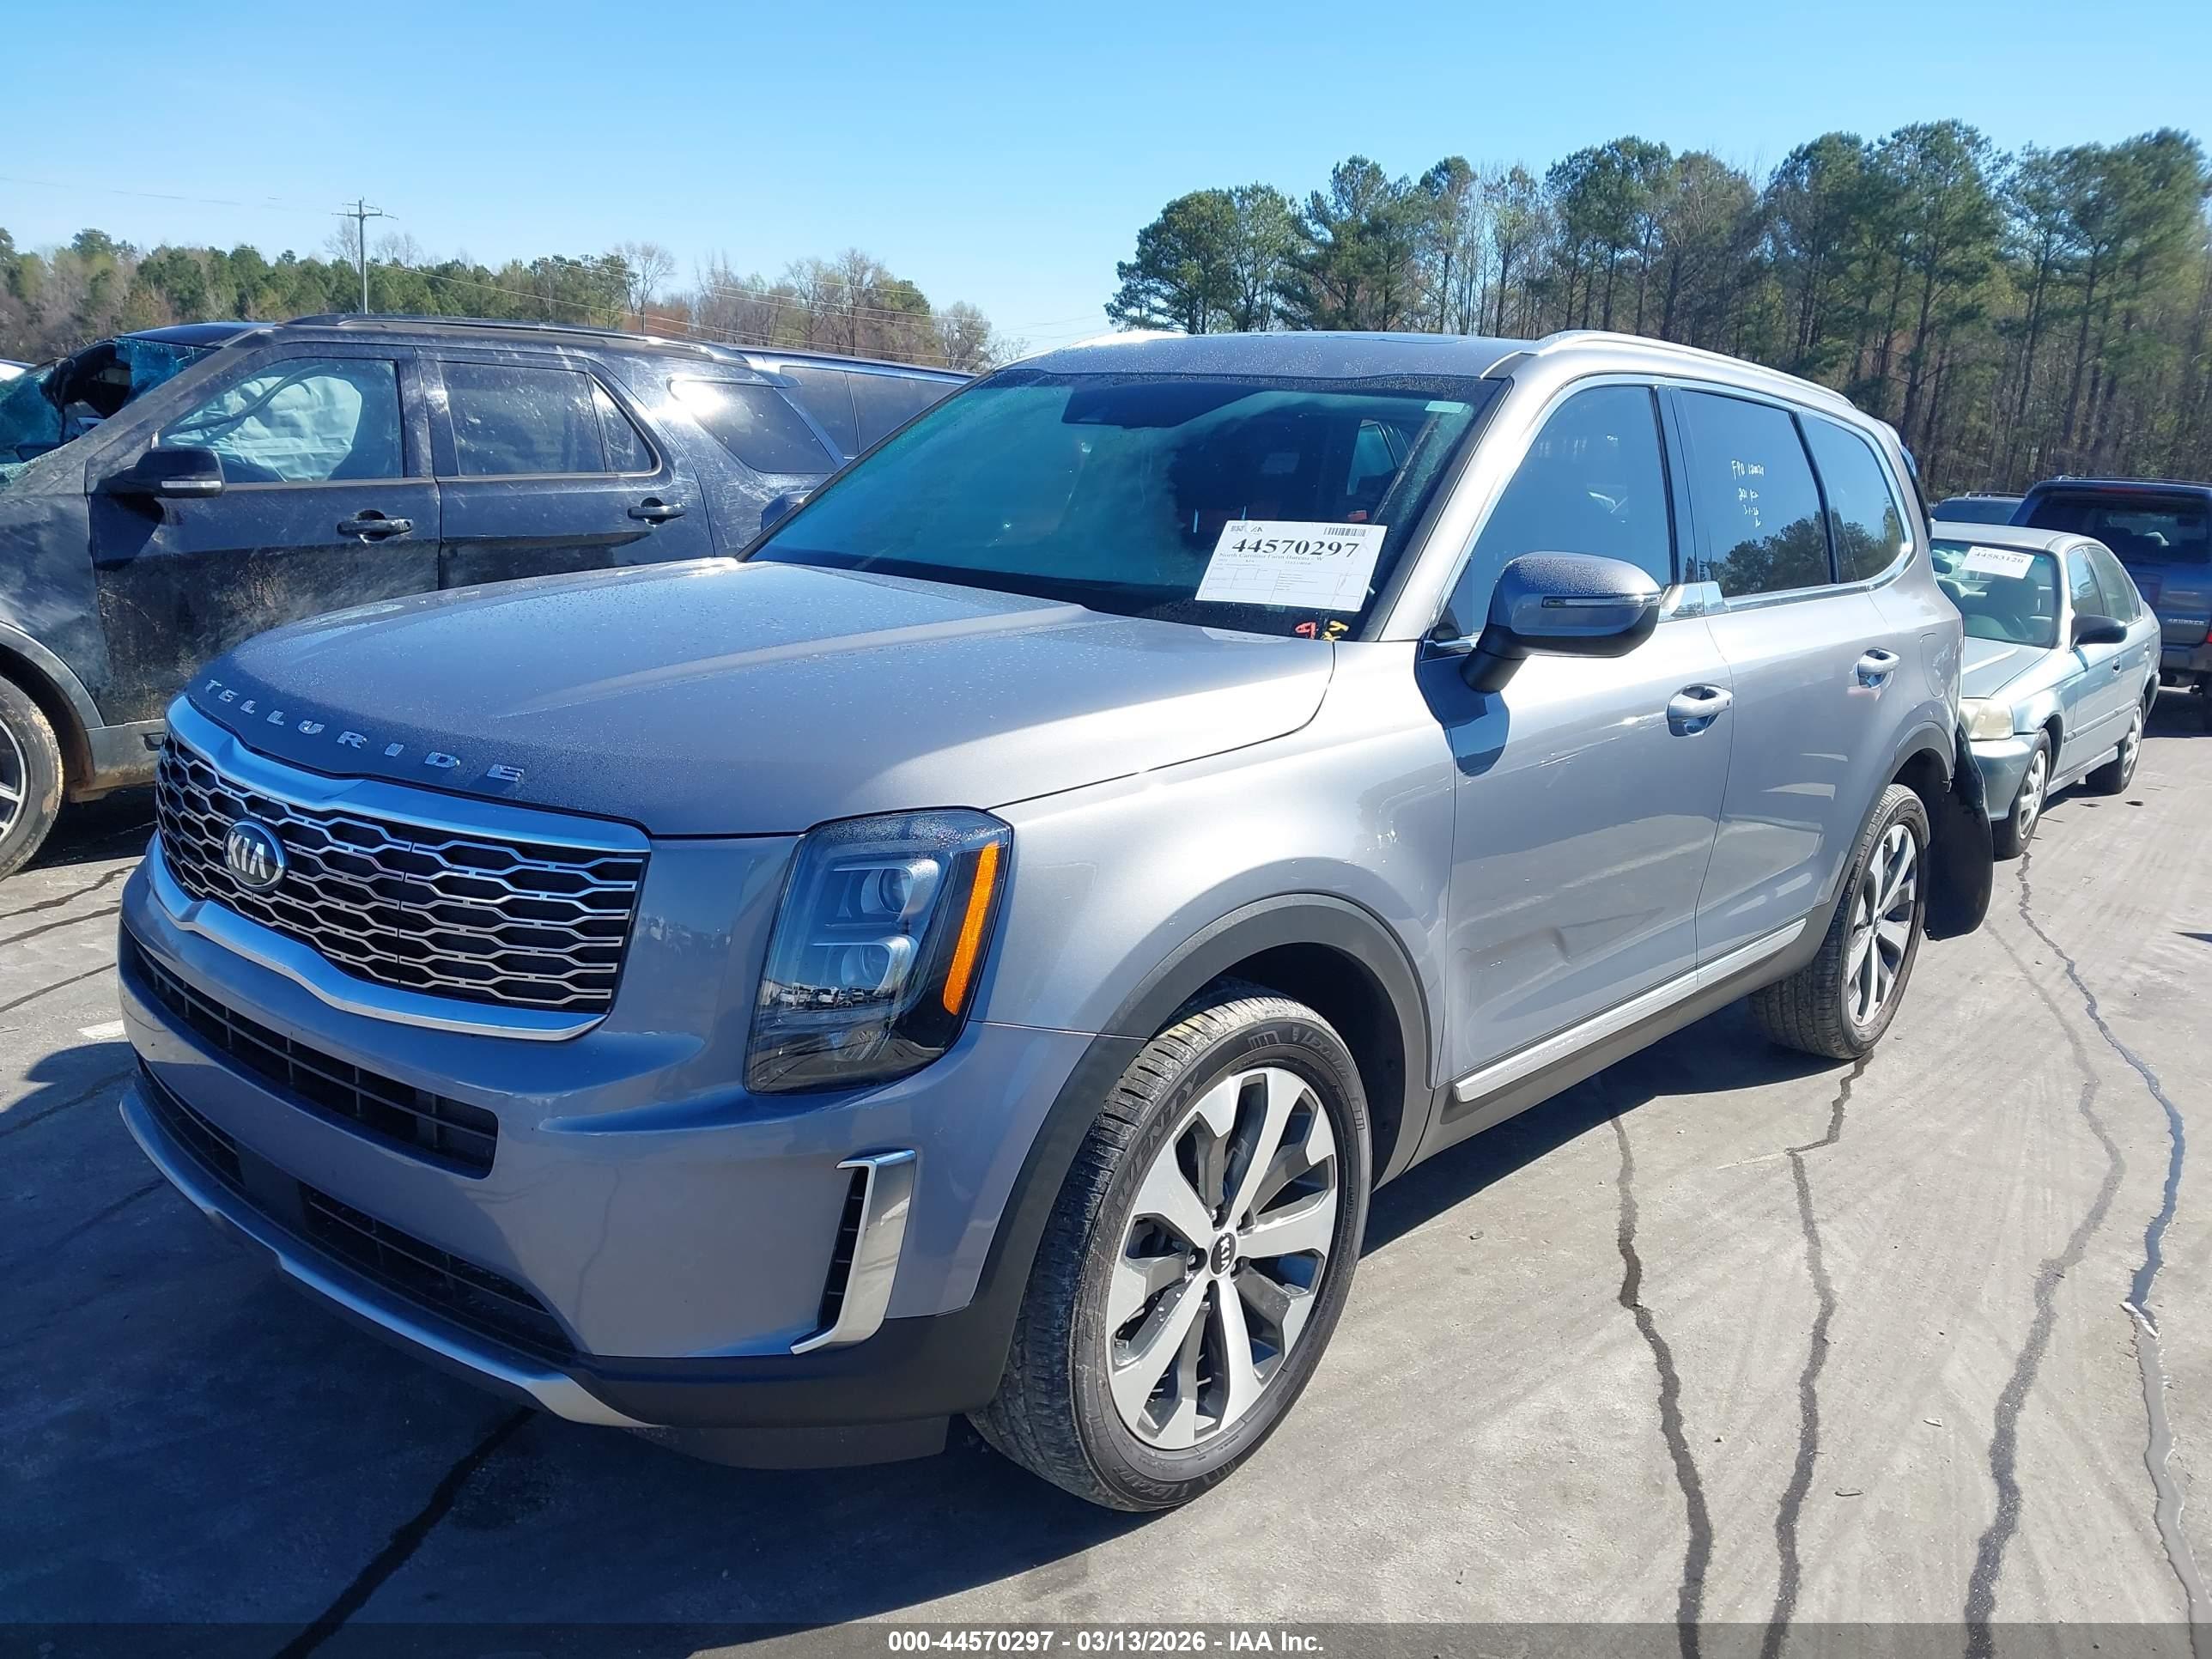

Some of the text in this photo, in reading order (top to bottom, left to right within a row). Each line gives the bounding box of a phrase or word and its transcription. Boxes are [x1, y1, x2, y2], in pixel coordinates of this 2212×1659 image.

[1231, 538, 1359, 558] 44570297
[204, 678, 526, 782] TELLURIDE
[227, 830, 269, 880] KIA
[1219, 1237, 1231, 1271] KIA
